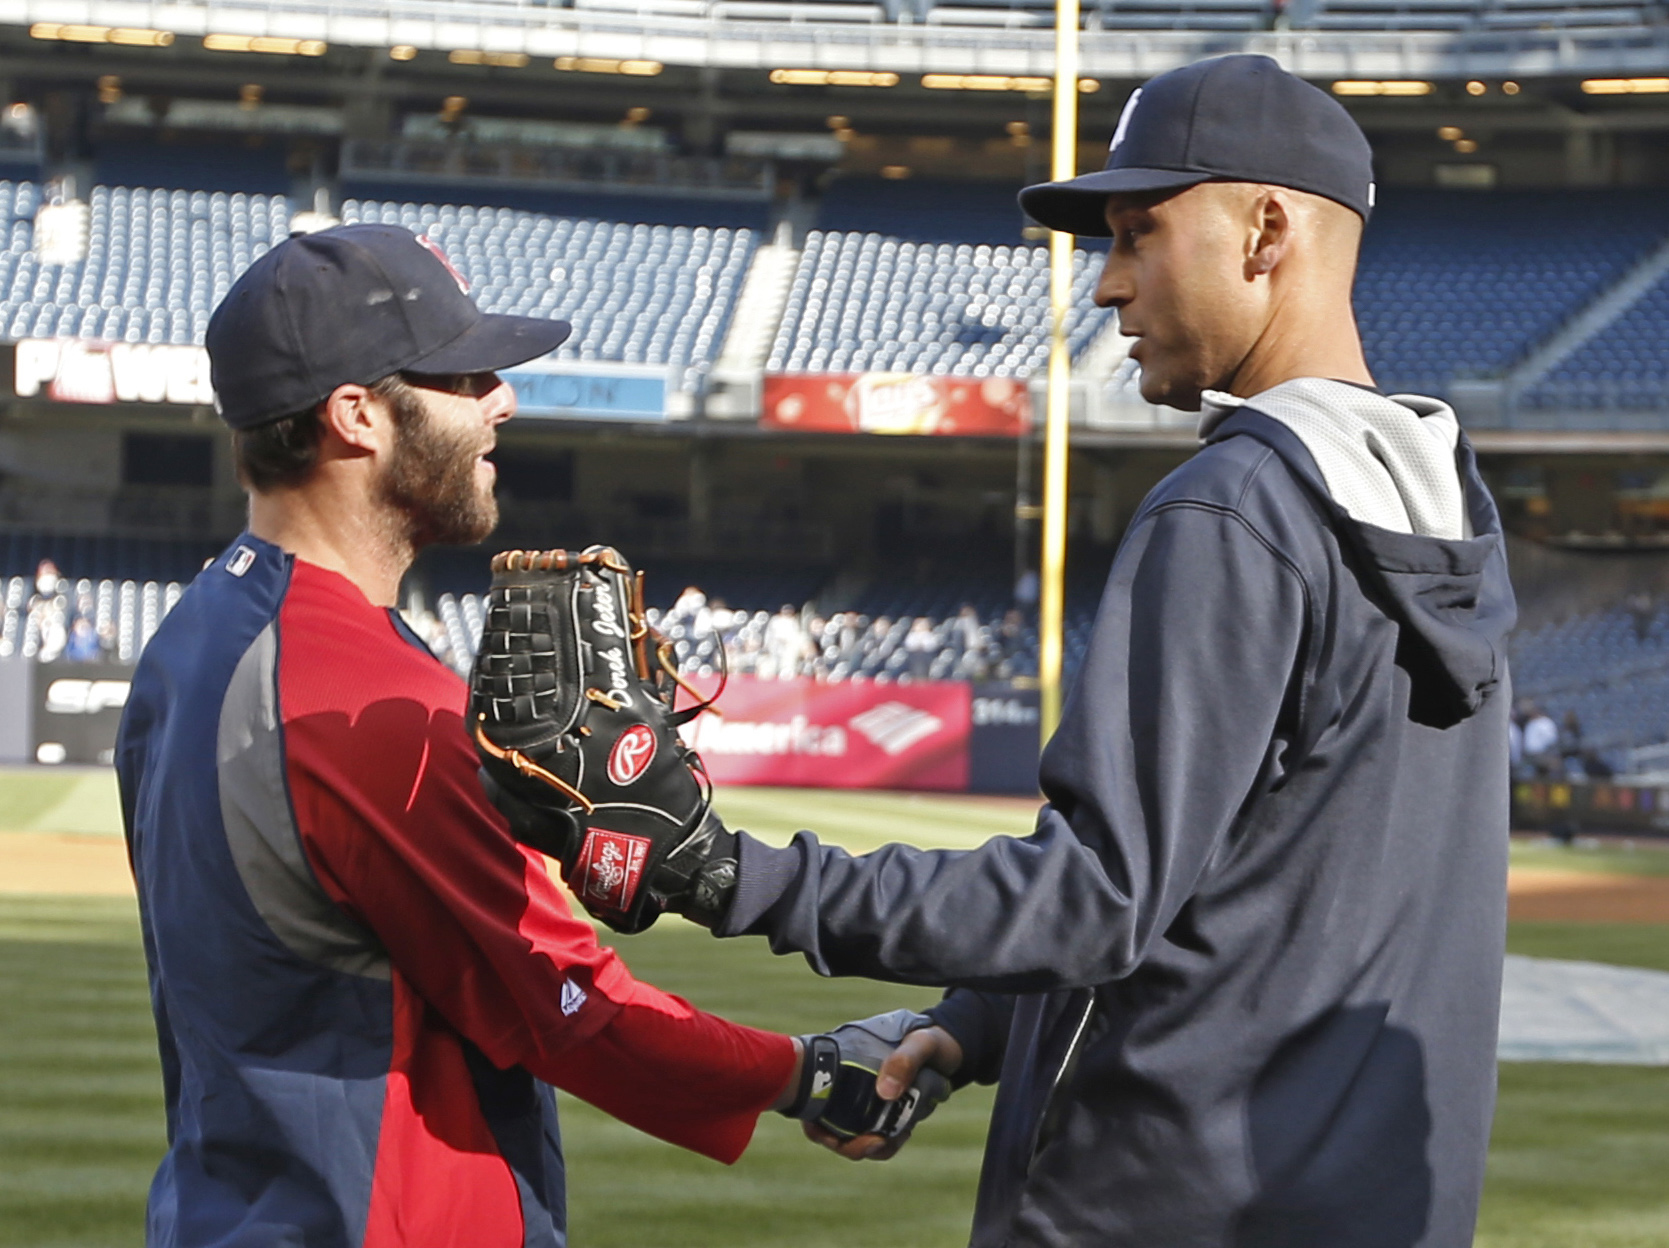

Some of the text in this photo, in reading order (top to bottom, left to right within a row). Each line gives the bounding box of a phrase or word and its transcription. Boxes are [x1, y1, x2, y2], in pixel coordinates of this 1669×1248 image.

[592, 583, 633, 708] Derek Jeter
[693, 711, 847, 757] America
[588, 840, 624, 900] Rawlings
